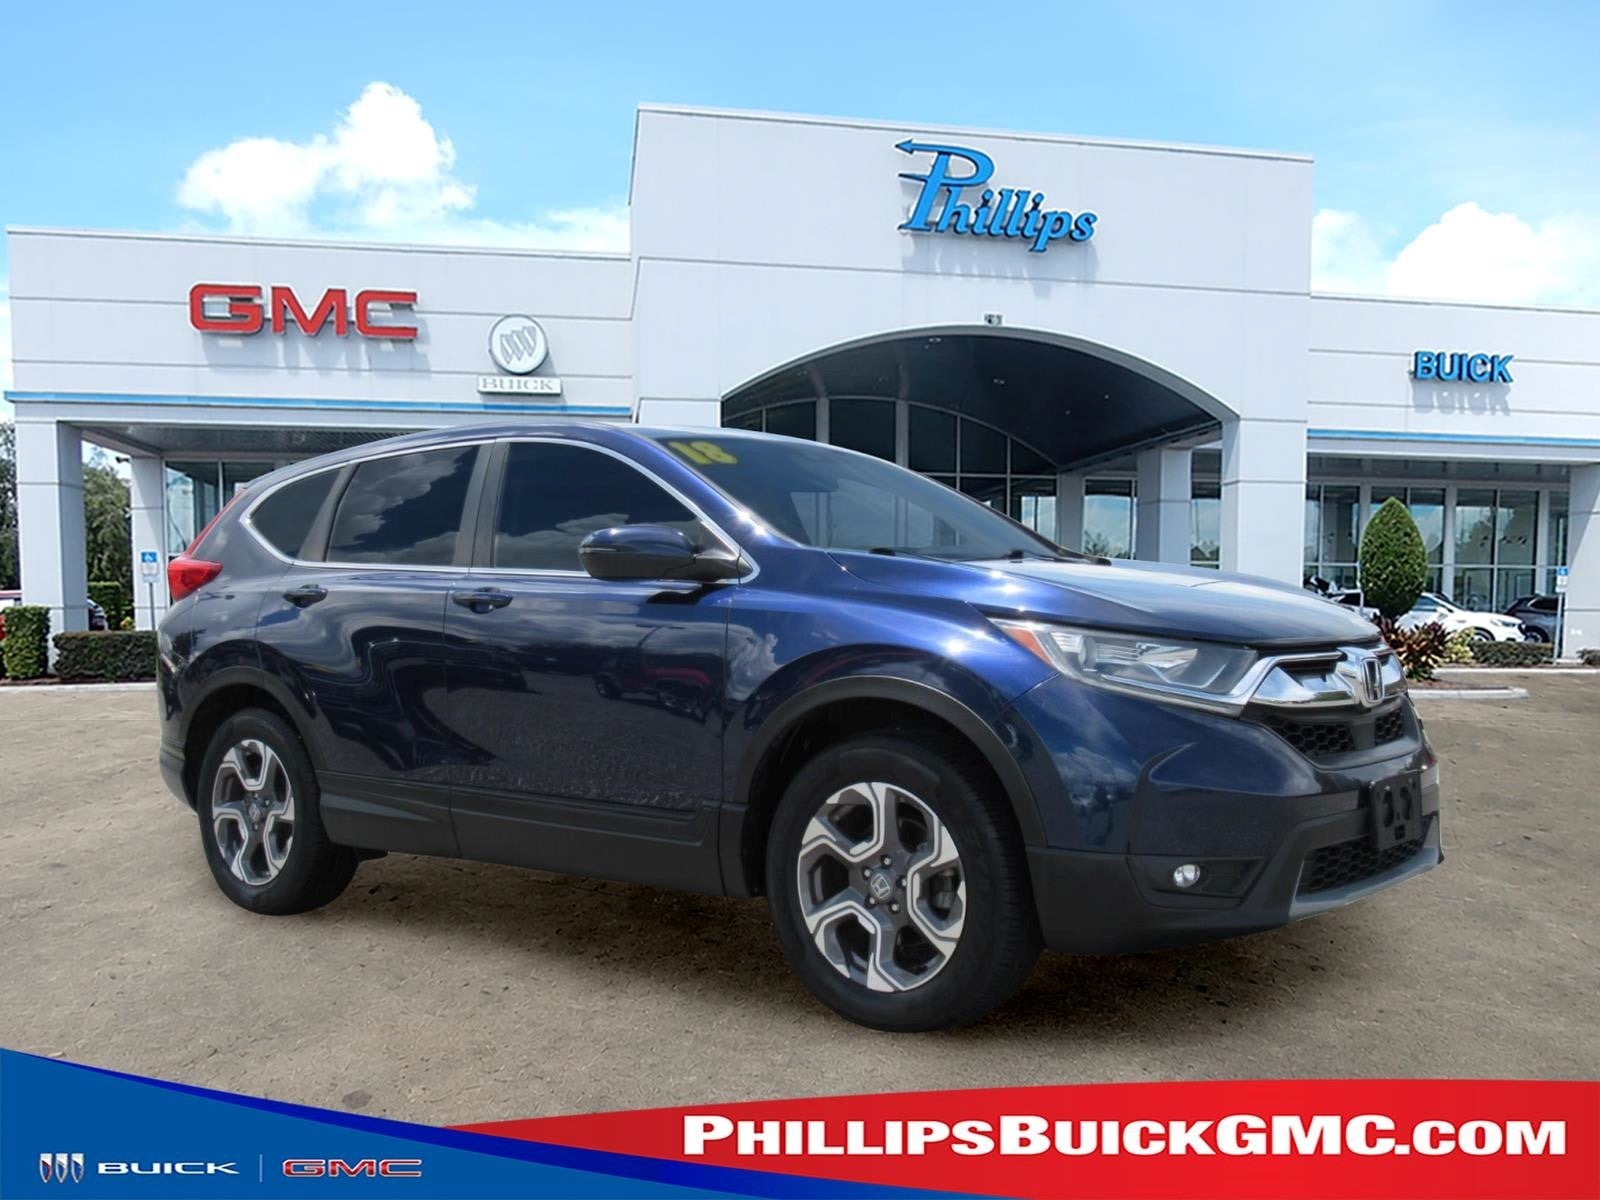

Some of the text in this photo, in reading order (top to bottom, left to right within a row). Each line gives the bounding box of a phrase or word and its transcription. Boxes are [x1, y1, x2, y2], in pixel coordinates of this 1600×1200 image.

[894, 138, 1098, 253] Phillips
[189, 283, 418, 341] GMC
[1413, 350, 1514, 383] BUICK
[481, 378, 553, 391] BUICK
[667, 440, 738, 465] 18
